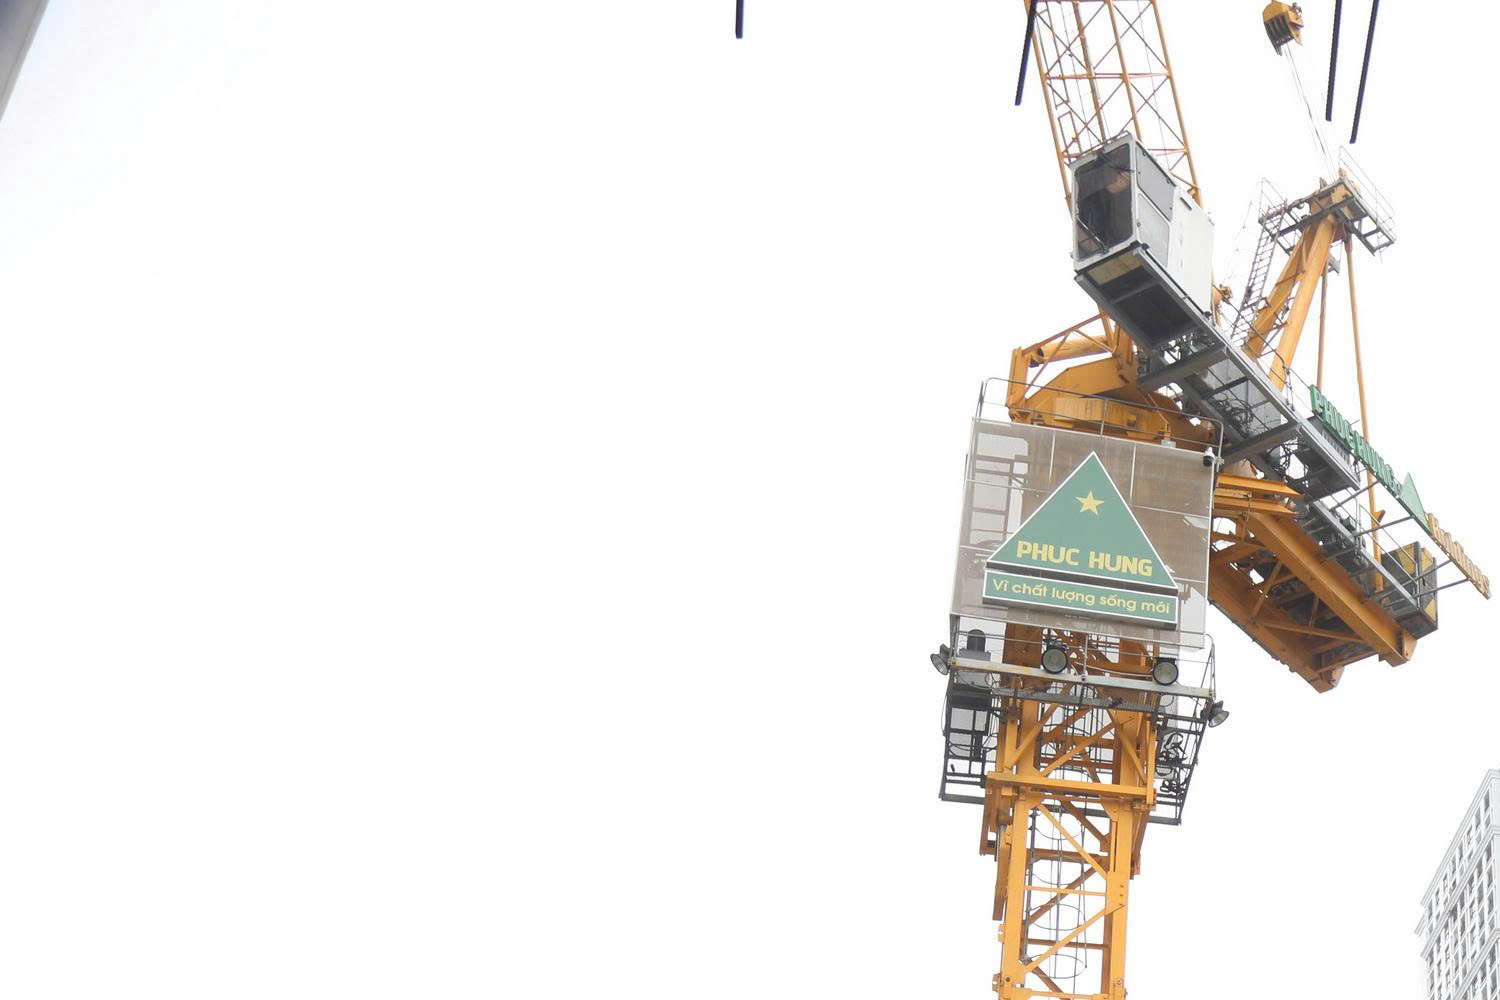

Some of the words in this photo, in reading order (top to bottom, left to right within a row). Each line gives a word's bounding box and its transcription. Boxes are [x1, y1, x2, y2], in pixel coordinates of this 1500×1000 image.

[1016, 540, 1080, 566] PHUC
[1088, 551, 1153, 577] HUNG
[992, 578, 1008, 592] Vì
[1012, 582, 1048, 597] chất
[1052, 587, 1096, 606] lượng
[1100, 594, 1137, 612] sống
[1141, 600, 1170, 614] mới
